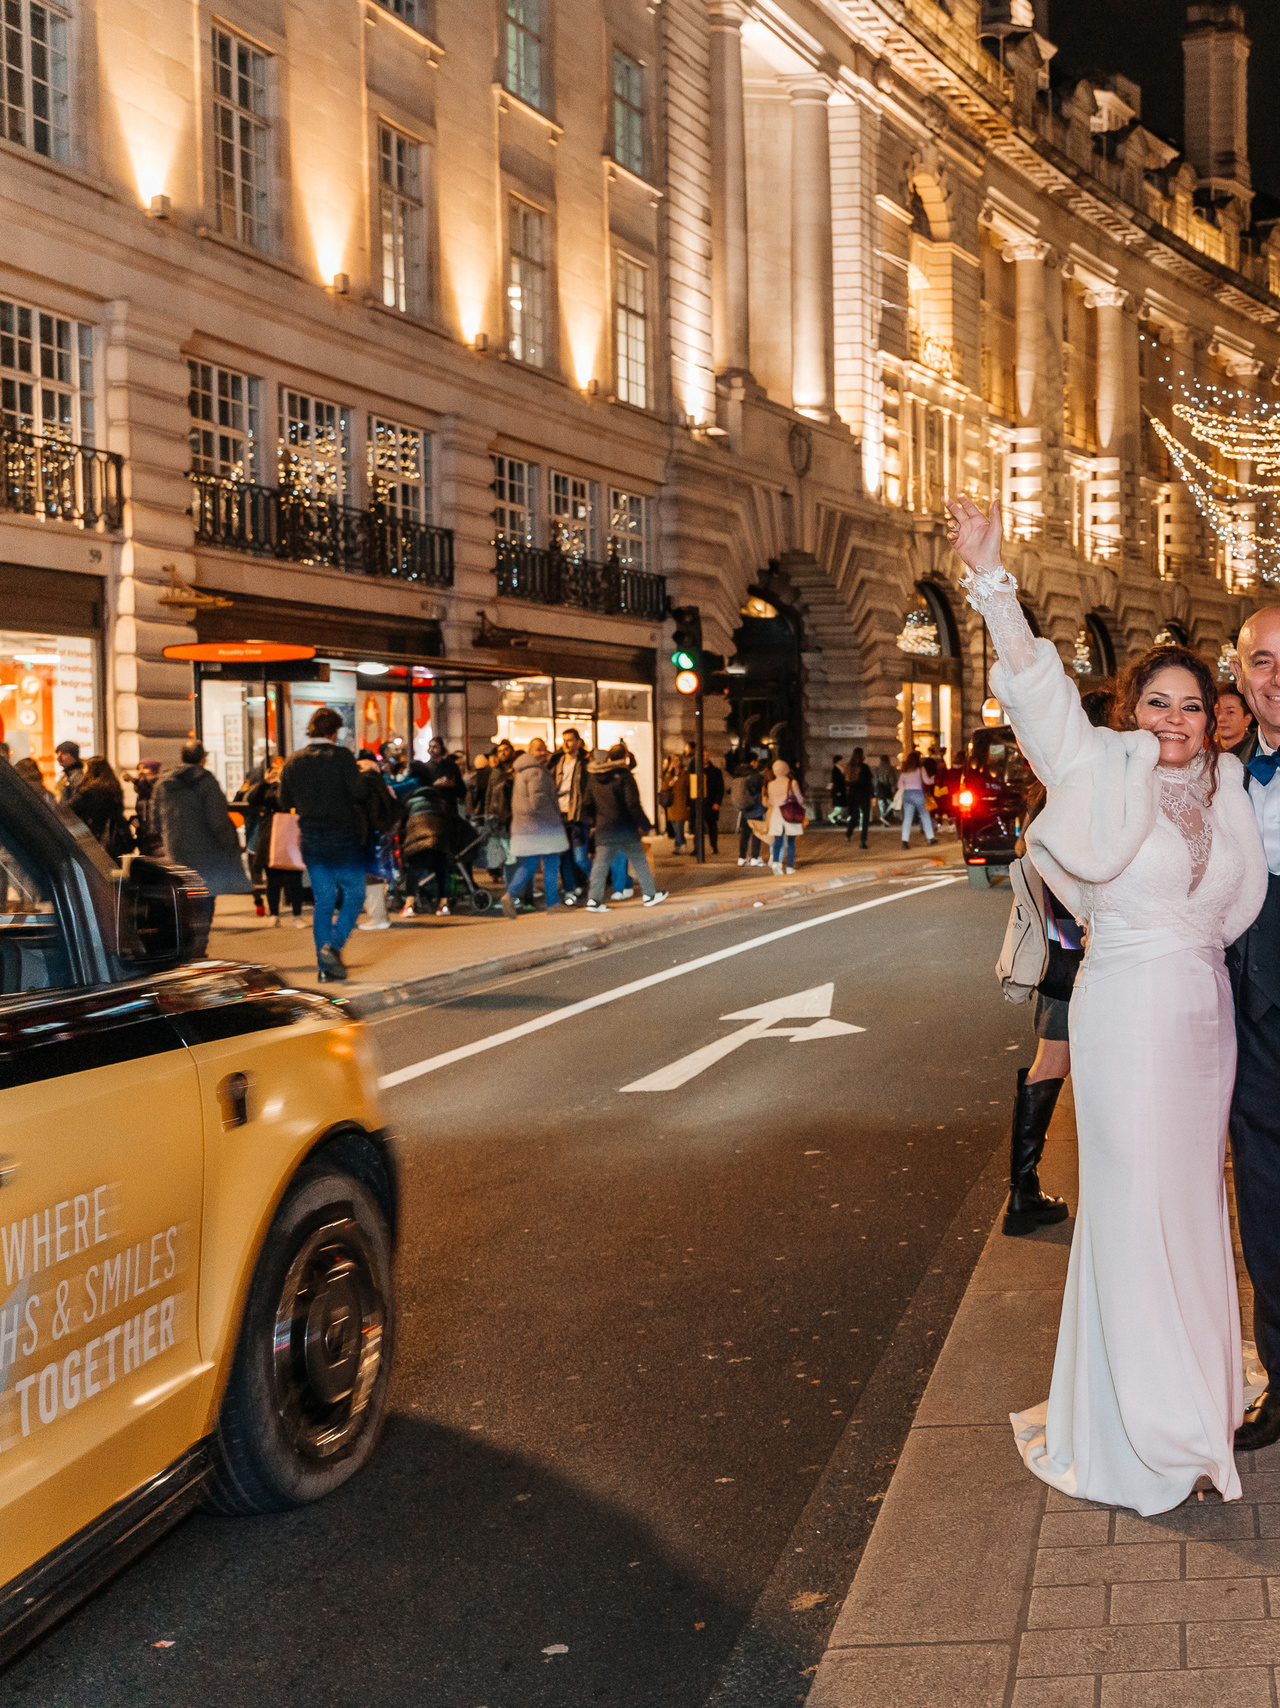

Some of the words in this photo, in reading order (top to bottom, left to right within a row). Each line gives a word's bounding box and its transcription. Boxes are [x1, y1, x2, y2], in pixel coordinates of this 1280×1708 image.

[1, 1184, 107, 1286] WHERE
[52, 1279, 71, 1341] &
[83, 1225, 177, 1323] SMILES
[15, 1295, 175, 1438] TOGETHER
